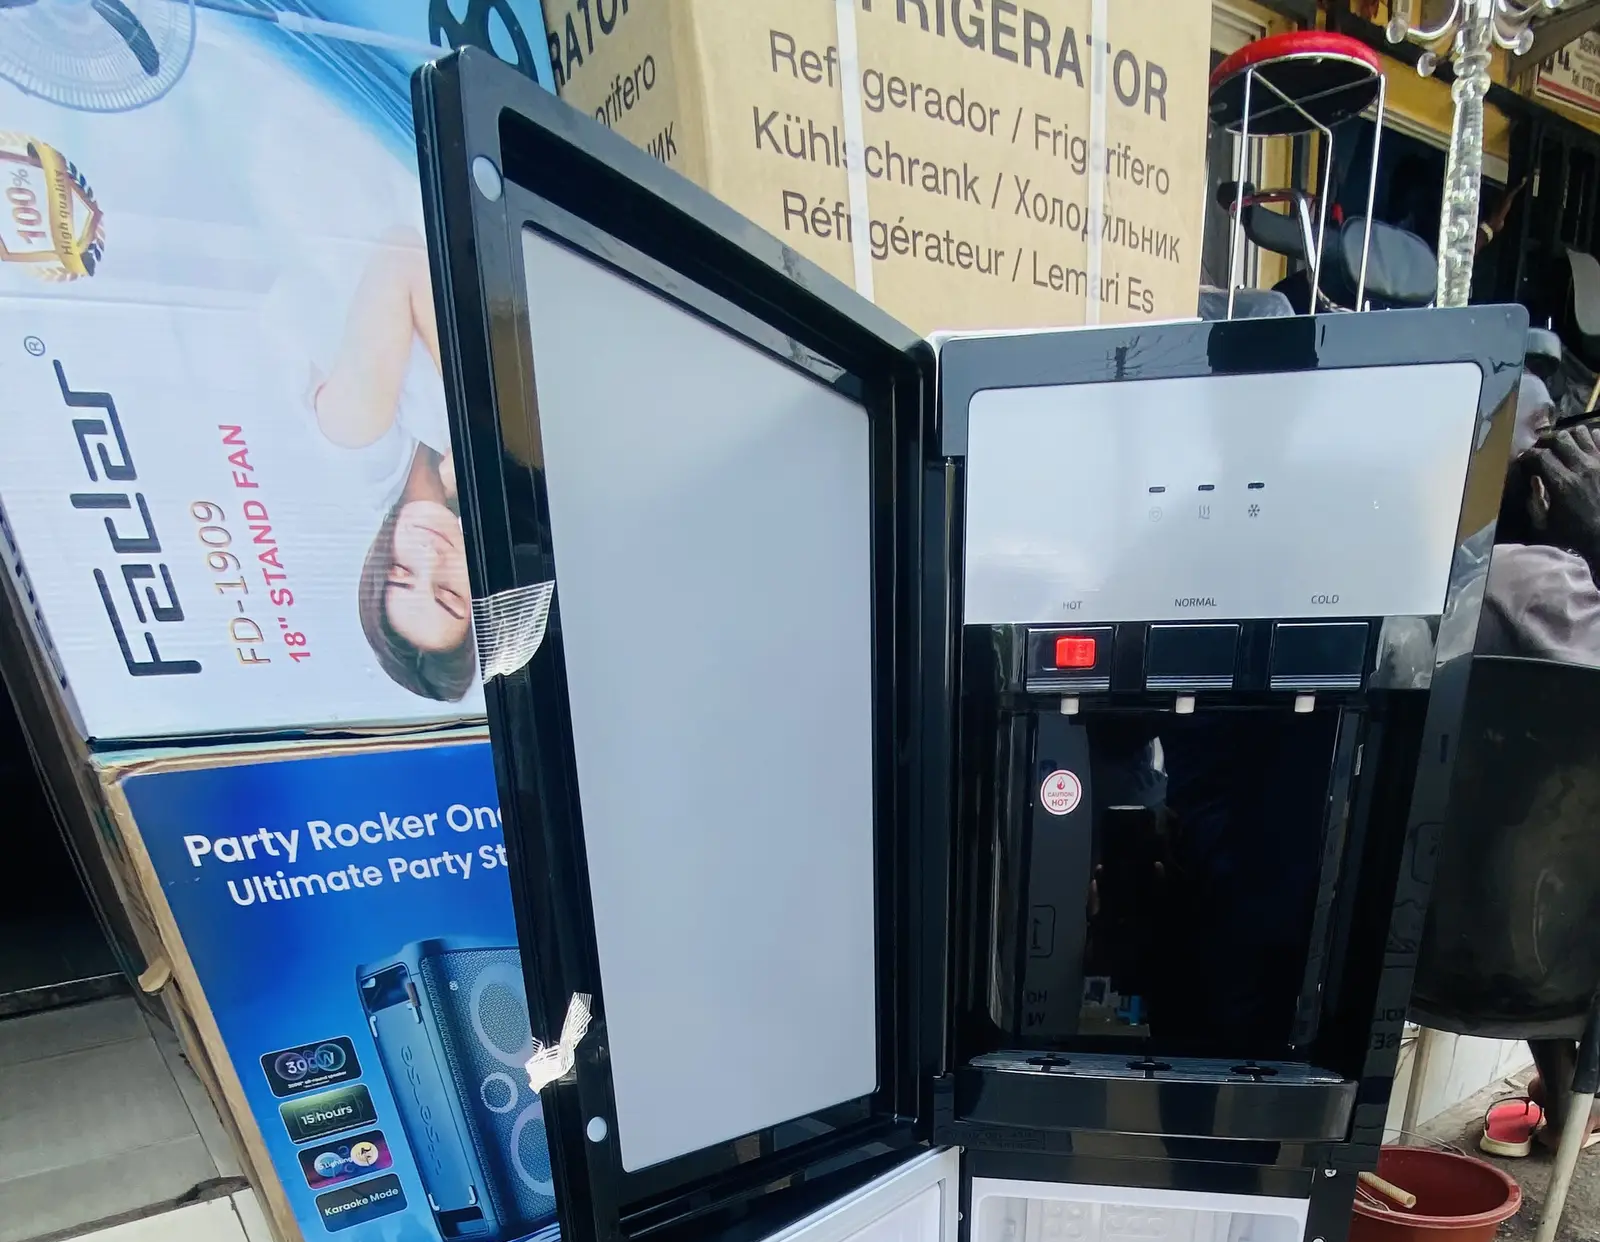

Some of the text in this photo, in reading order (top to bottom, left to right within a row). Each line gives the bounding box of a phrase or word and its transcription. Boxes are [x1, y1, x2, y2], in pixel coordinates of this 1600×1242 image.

[770, 29, 1001, 136] Refgerador
[1034, 112, 1170, 195] Frigrifero
[6, 168, 47, 245] 100%
[54, 170, 73, 255] High quality
[782, 190, 1005, 275] Réfrgérateur
[1128, 277, 1155, 314] Es
[218, 424, 260, 488] FAN
[243, 500, 295, 607] STAND
[190, 500, 272, 665] FD-1909
[1062, 601, 1083, 610] HOT
[1174, 597, 1218, 608] NORMAL
[1311, 594, 1340, 605] COLD
[1051, 798, 1069, 807] HOT
[184, 827, 299, 867] Party
[307, 811, 438, 851] Rocker
[227, 864, 383, 906] Ultimate
[387, 850, 473, 883] Party
[301, 1105, 354, 1125] 15 hours
[324, 1187, 399, 1217] Karaoke Mode
